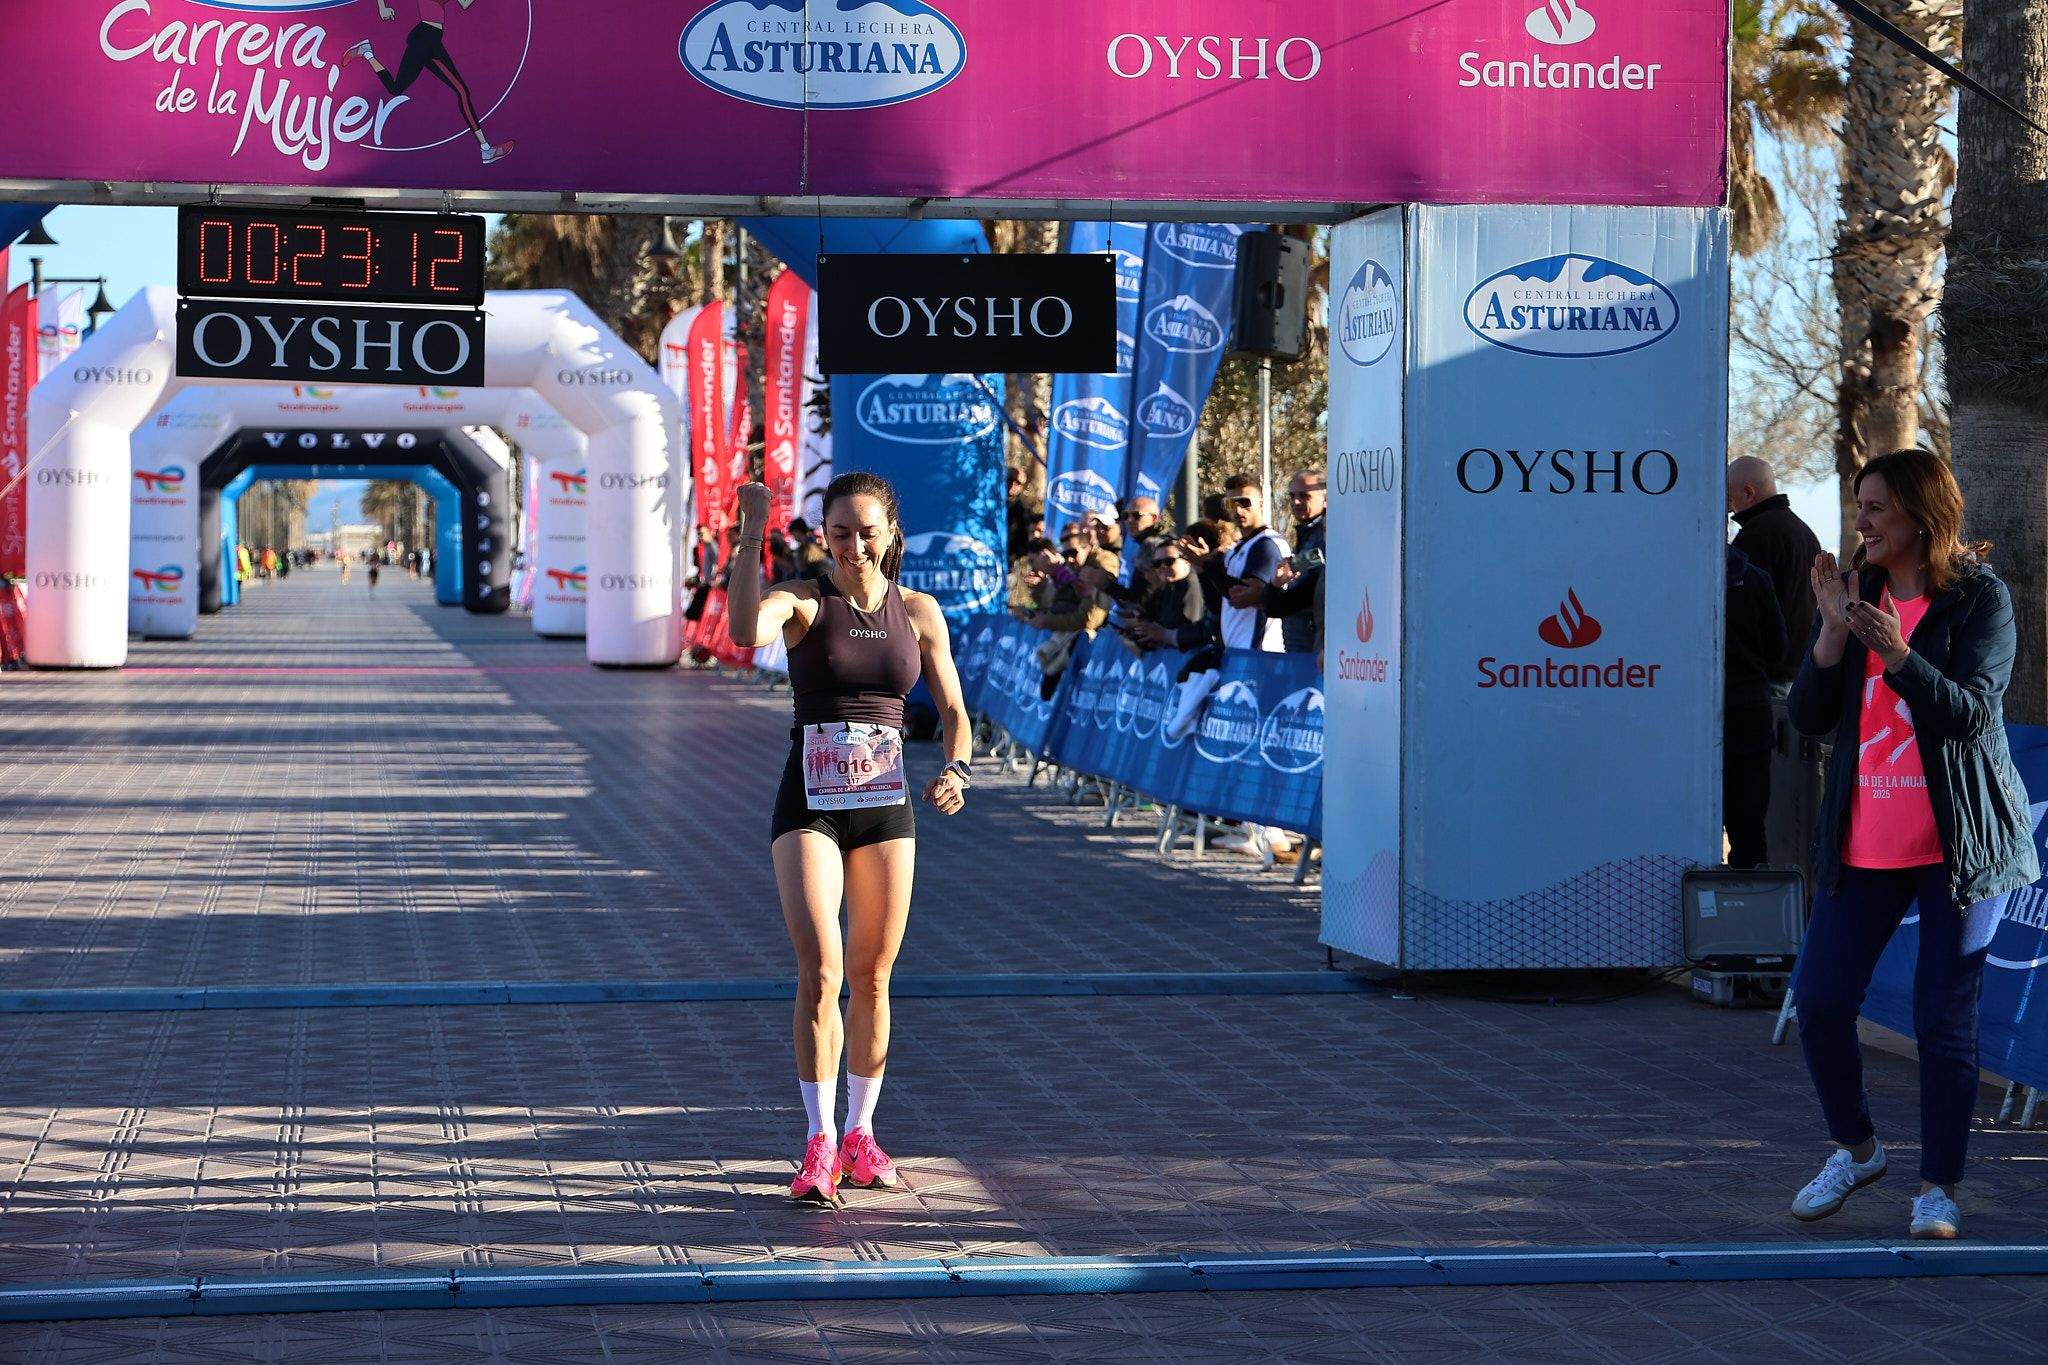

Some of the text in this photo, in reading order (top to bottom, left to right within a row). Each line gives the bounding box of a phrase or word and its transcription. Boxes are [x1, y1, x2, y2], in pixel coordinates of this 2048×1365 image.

[99, 1, 328, 66] Carrera
[747, 20, 935, 36] CENTRAL LECHERA
[701, 21, 945, 76] ASTURIANA
[1107, 34, 1322, 82] OYSHO
[1459, 51, 1661, 91] Santander
[155, 66, 410, 171] de la Mujer
[1480, 290, 1662, 333] ASTURIANA
[1514, 289, 1657, 301] CENTRAL LECHERA
[867, 296, 1073, 338] OYSHO
[1343, 304, 1394, 342] ASTURIANA
[192, 311, 471, 376] OYSHO
[3, 322, 22, 447] Santander
[74, 367, 151, 385] OYSHO
[558, 368, 633, 385] OYSHO
[775, 300, 799, 437] Santander
[700, 338, 716, 456] Santander
[263, 432, 418, 449] VOLVO
[1337, 447, 1394, 495] OYSHO
[1456, 448, 1679, 495] OYSHO
[849, 628, 888, 639] OYSHO
[1338, 650, 1389, 684] Santander
[1477, 656, 1661, 689] Santander
[837, 759, 872, 774] 016
[1872, 775, 1883, 787] DE
[1886, 776, 1898, 788] LA
[1901, 776, 1927, 788] MUJE
[818, 795, 894, 806] OYSHO Santander
